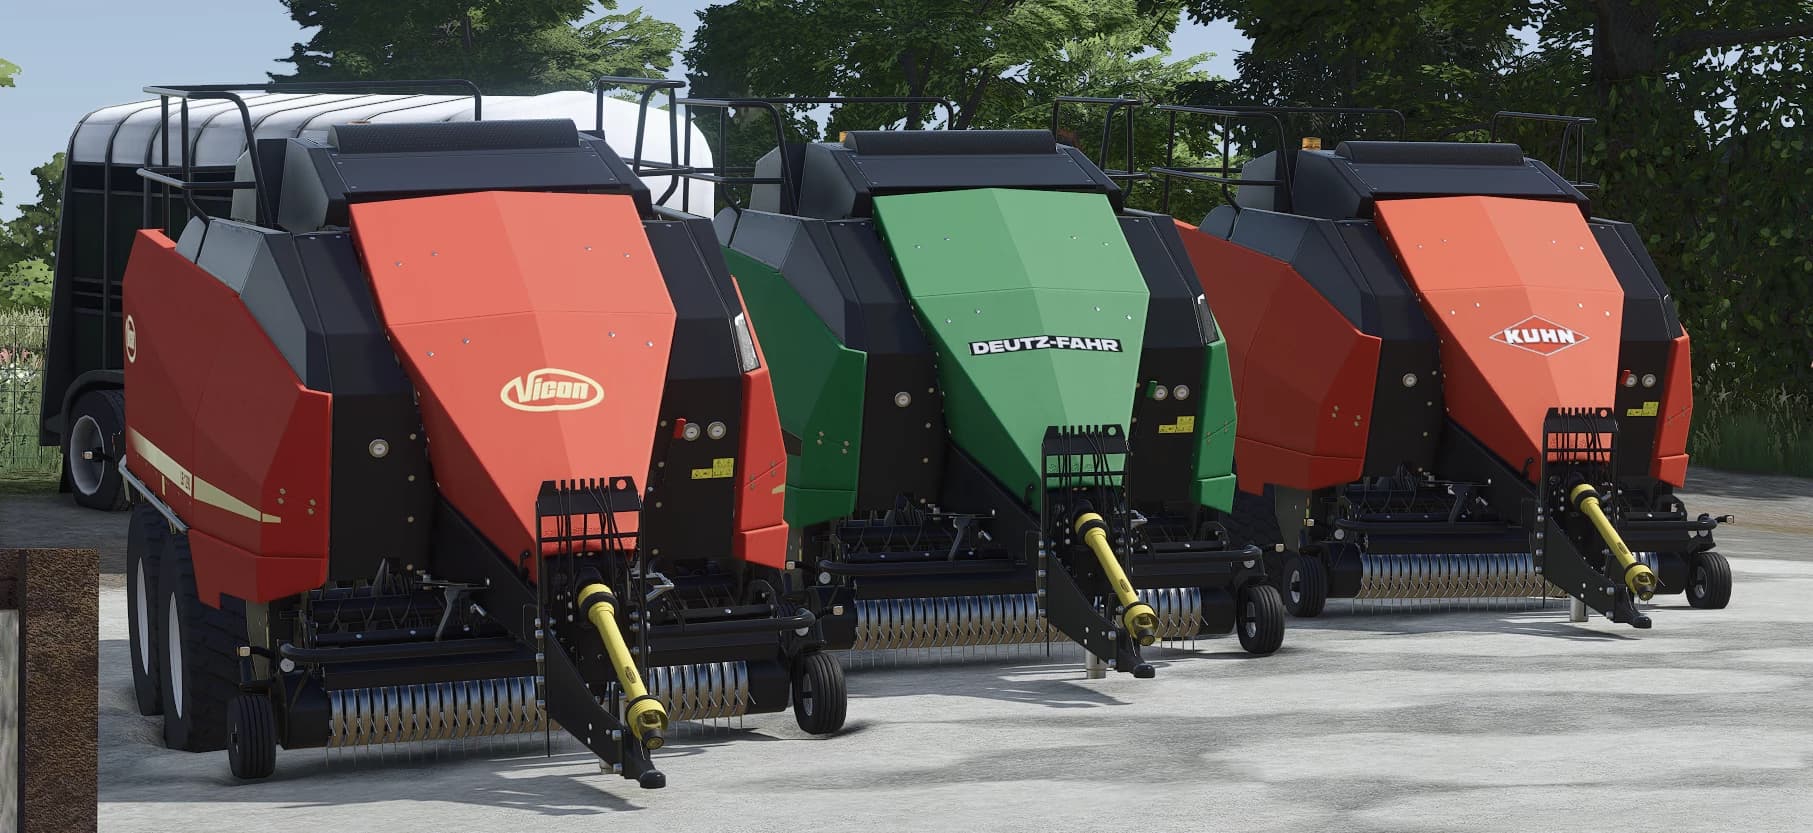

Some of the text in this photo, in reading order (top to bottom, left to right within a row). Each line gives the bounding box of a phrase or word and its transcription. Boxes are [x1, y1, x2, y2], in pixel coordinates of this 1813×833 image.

[972, 335, 1120, 355] DEUTZ-FAHR
[1504, 328, 1575, 344] KUHN
[510, 372, 591, 404] Vicon
